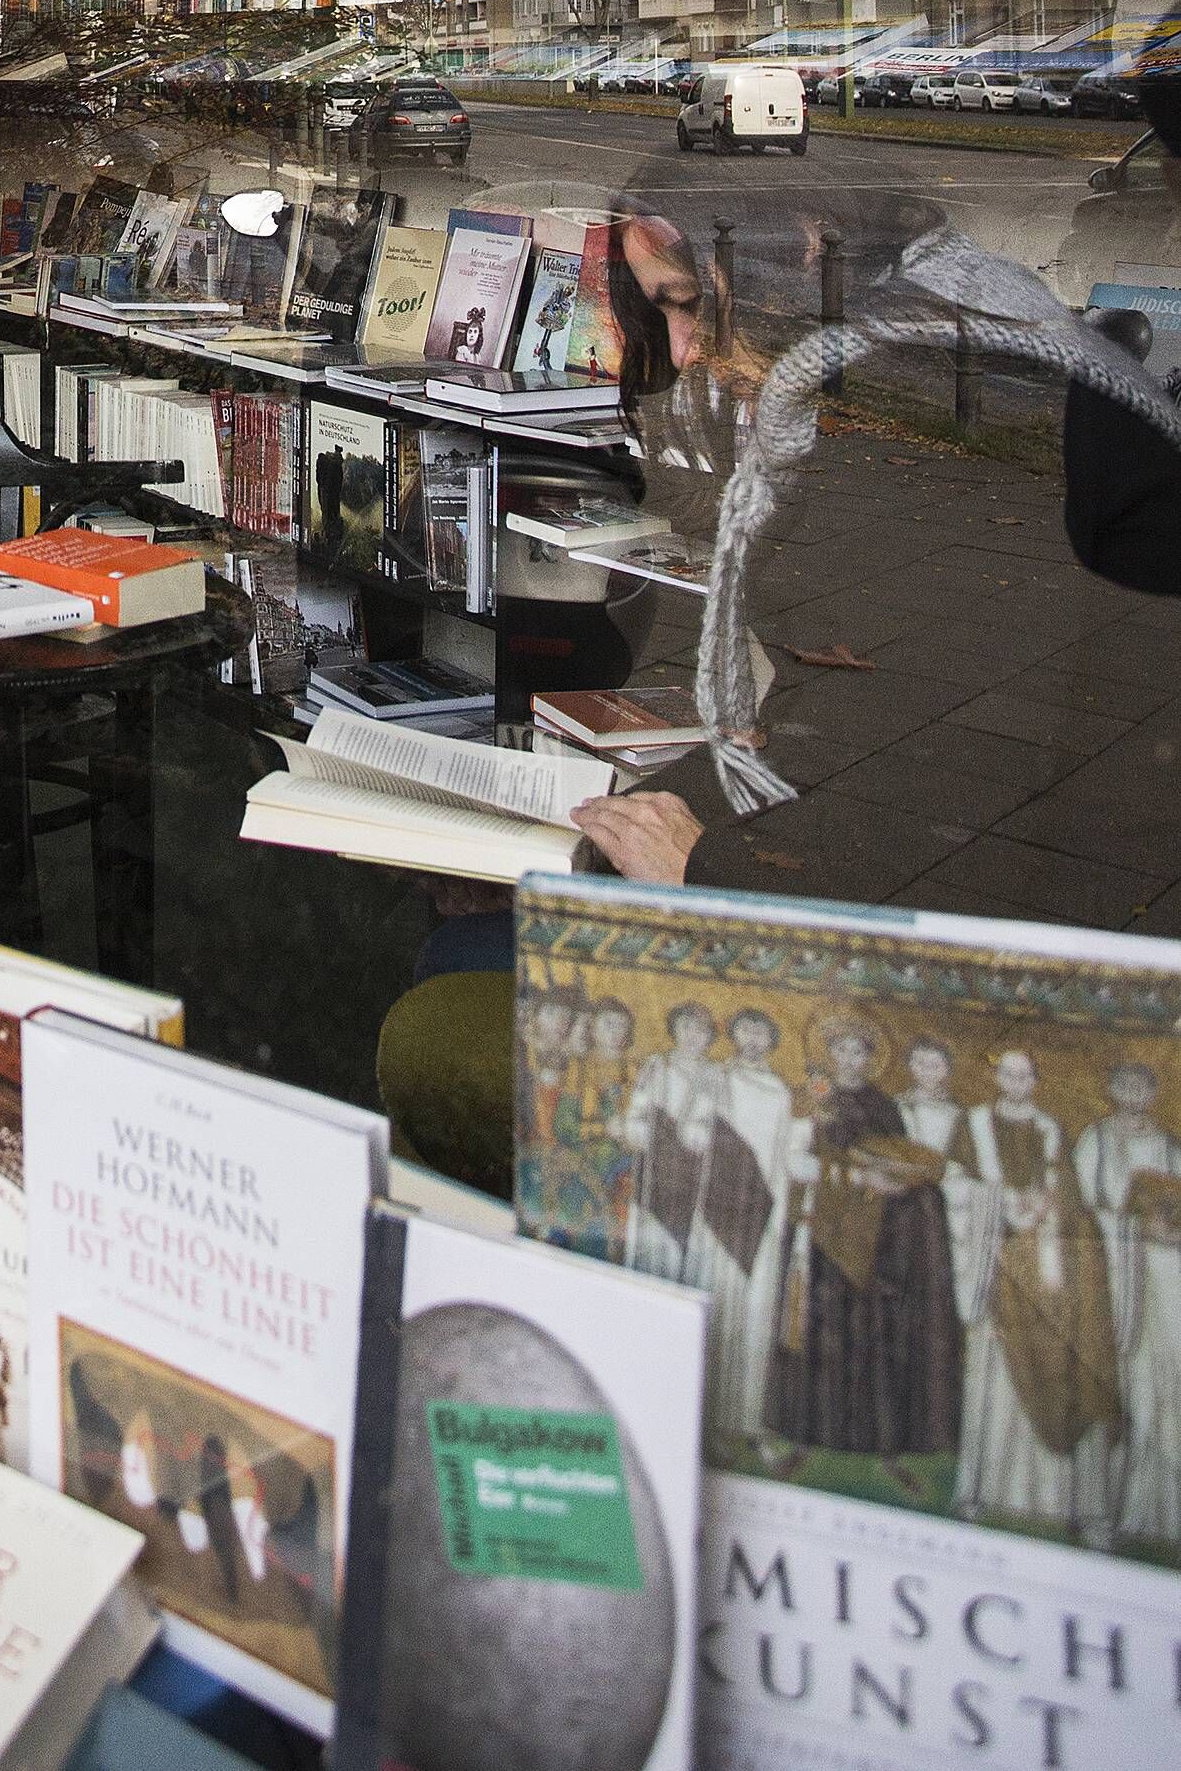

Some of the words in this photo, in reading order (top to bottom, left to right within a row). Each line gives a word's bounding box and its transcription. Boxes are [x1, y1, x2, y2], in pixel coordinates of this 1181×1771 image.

[101, 196, 133, 219] Pompeji
[543, 257, 567, 272] Walter
[291, 306, 322, 320] PLANET
[294, 296, 308, 307] DER
[310, 298, 353, 316] GEDULDIGE
[221, 399, 232, 408] DAS
[319, 420, 353, 434] NATURSCHUTZ
[326, 430, 361, 446] DEUTSCHLAND
[113, 1116, 260, 1202] WERNER
[52, 1179, 100, 1226] DIE
[97, 1149, 278, 1248] HOFMANN
[68, 1223, 112, 1267] IST
[130, 1249, 203, 1307] EINE
[221, 1288, 315, 1360] LINIE
